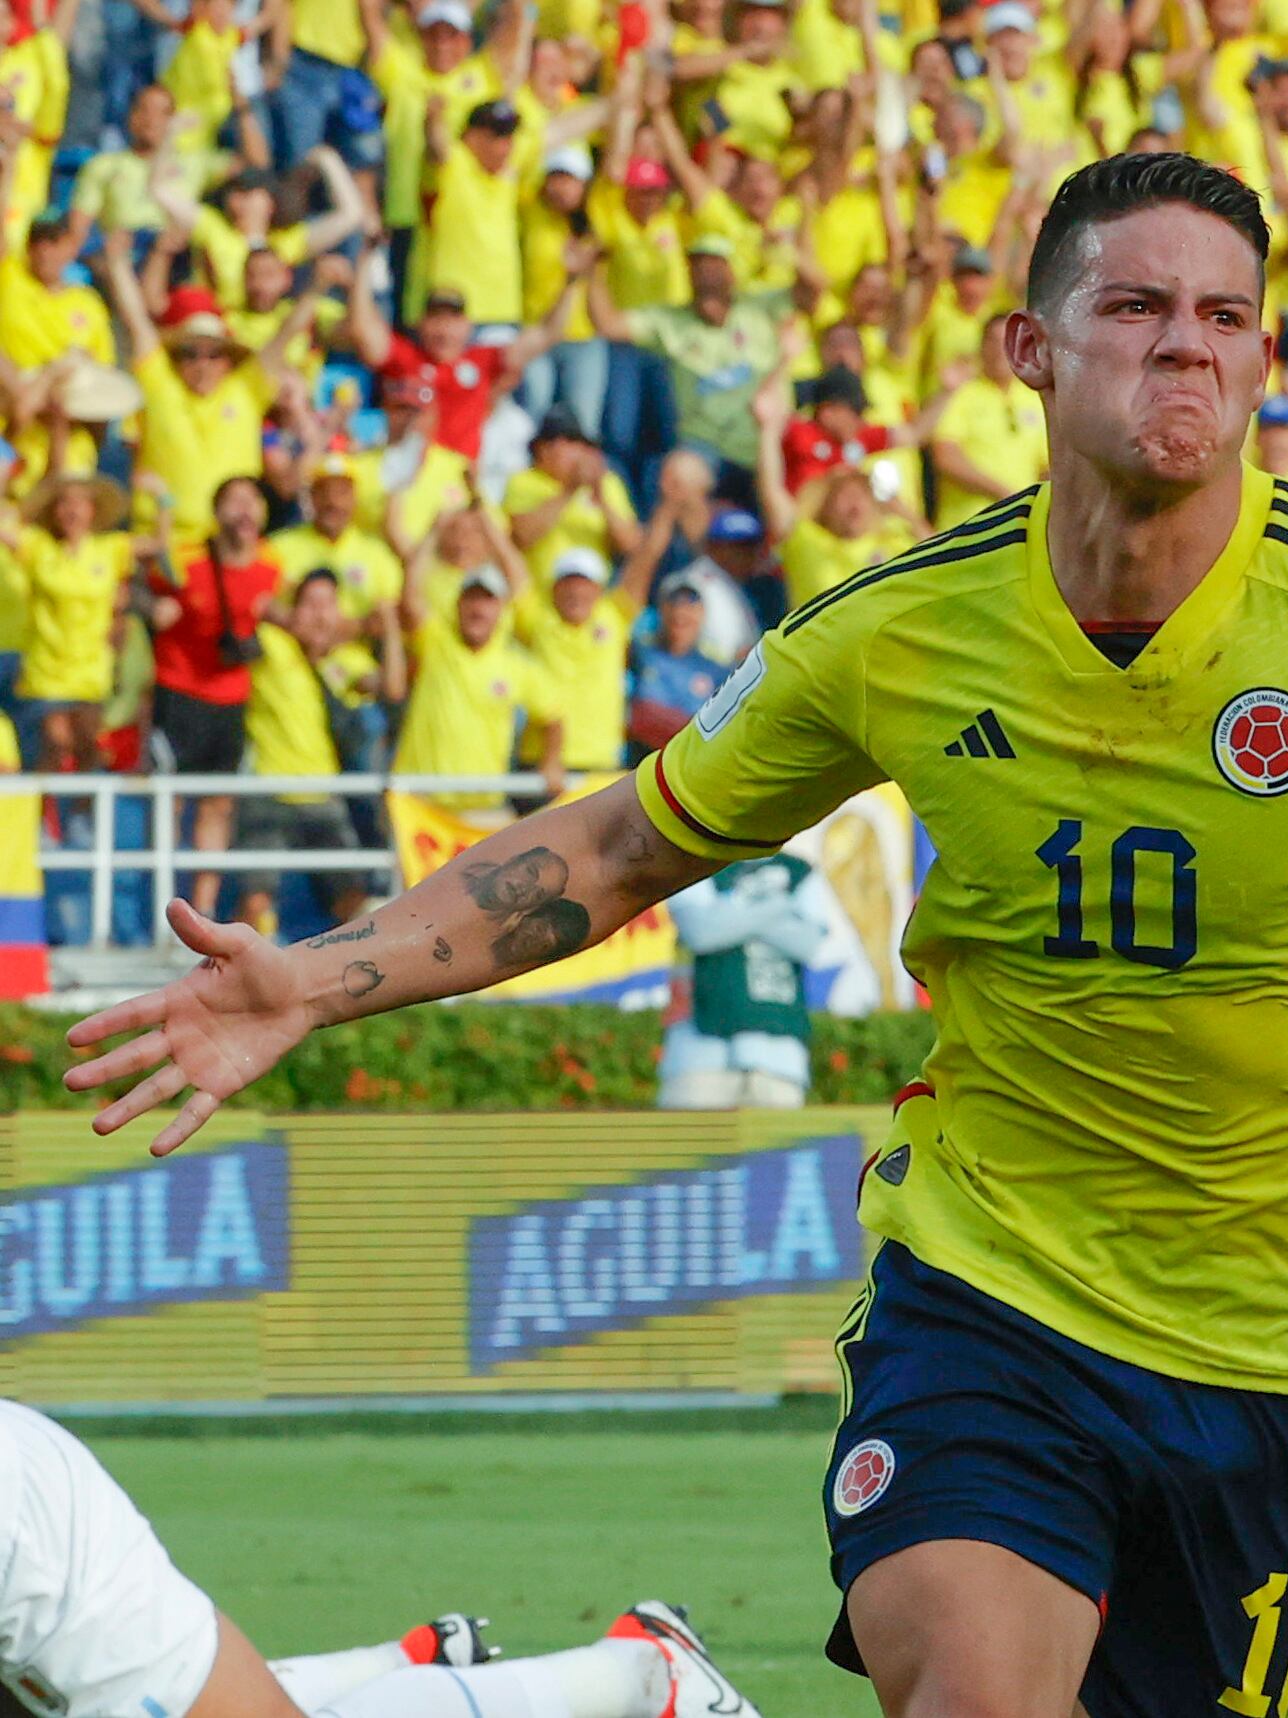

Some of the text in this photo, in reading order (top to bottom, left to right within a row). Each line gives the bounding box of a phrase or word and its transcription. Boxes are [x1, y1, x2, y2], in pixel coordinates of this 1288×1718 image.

[1035, 819, 1197, 970] 10
[0, 1154, 263, 1324] GUILA
[490, 1149, 840, 1347] AGUILA
